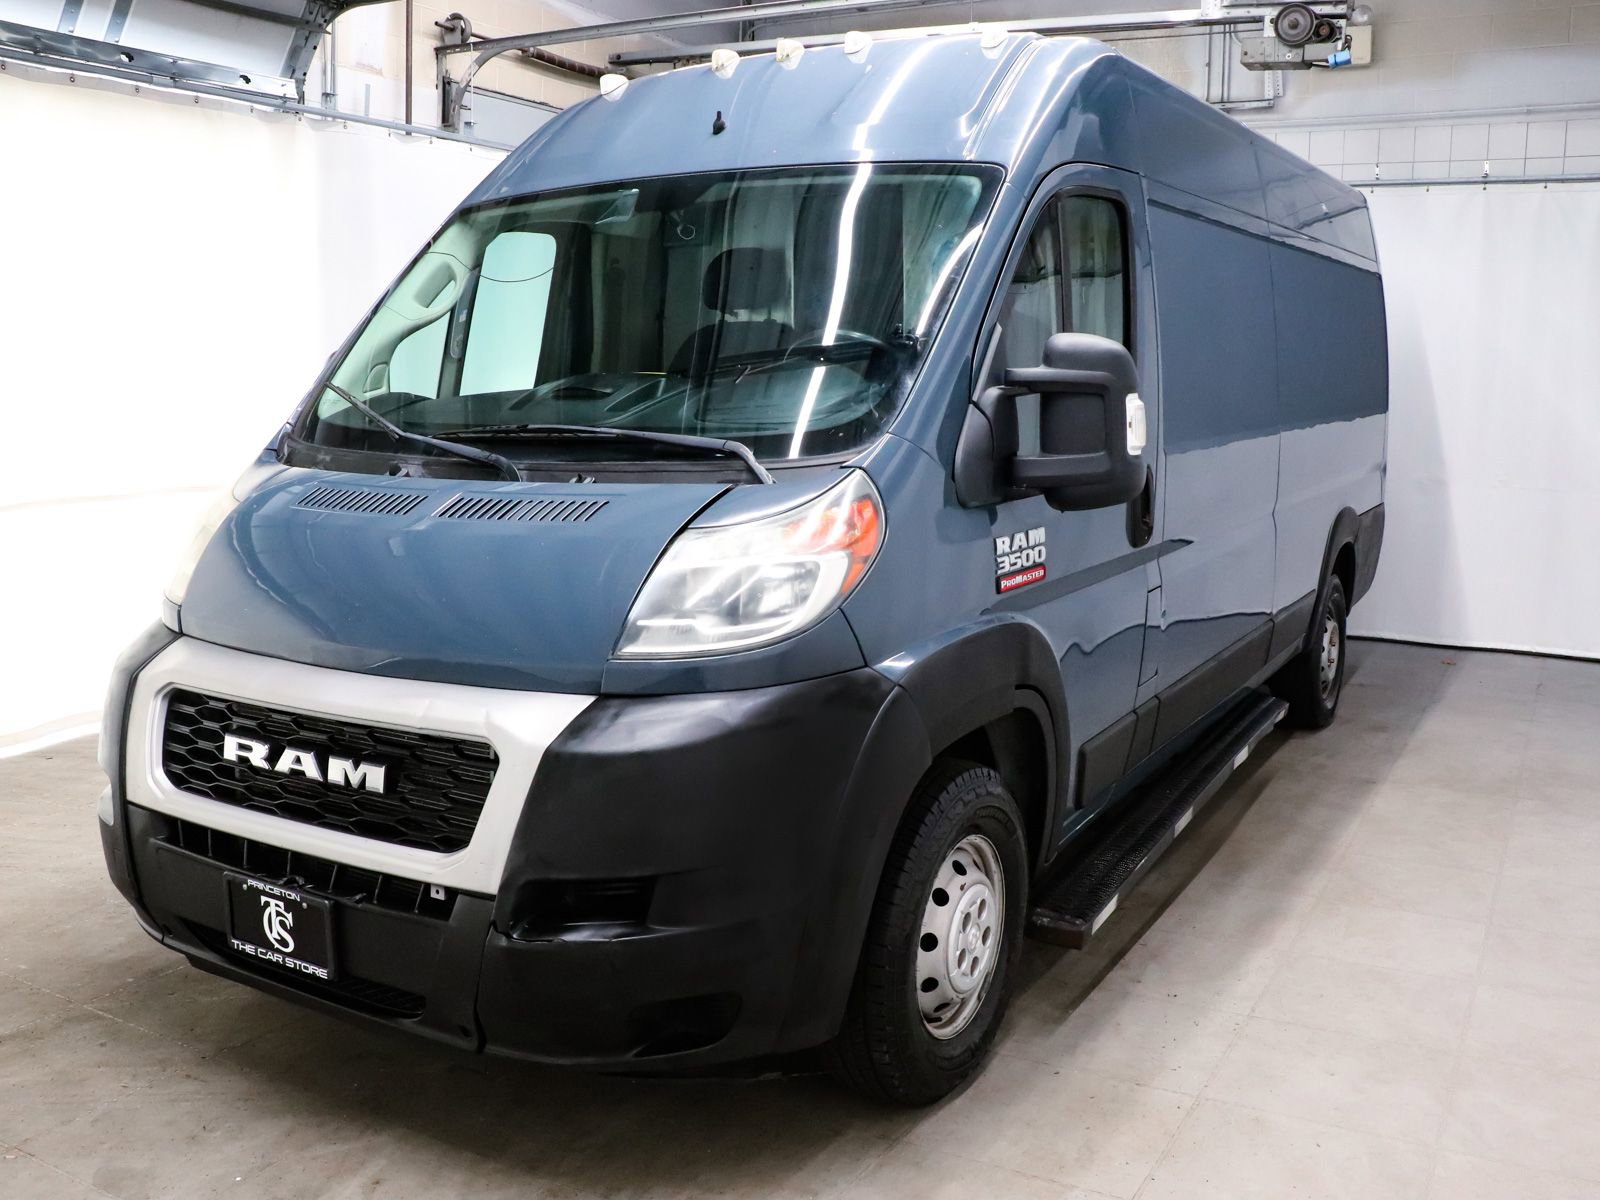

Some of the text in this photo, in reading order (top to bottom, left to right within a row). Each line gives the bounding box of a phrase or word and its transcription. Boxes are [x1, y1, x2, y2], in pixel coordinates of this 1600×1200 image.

[995, 526, 1046, 556] RAM
[996, 545, 1047, 575] 3500
[223, 732, 388, 794] RAM
[247, 879, 301, 902] PRINCETON
[231, 939, 328, 980] THE CAR STORE
